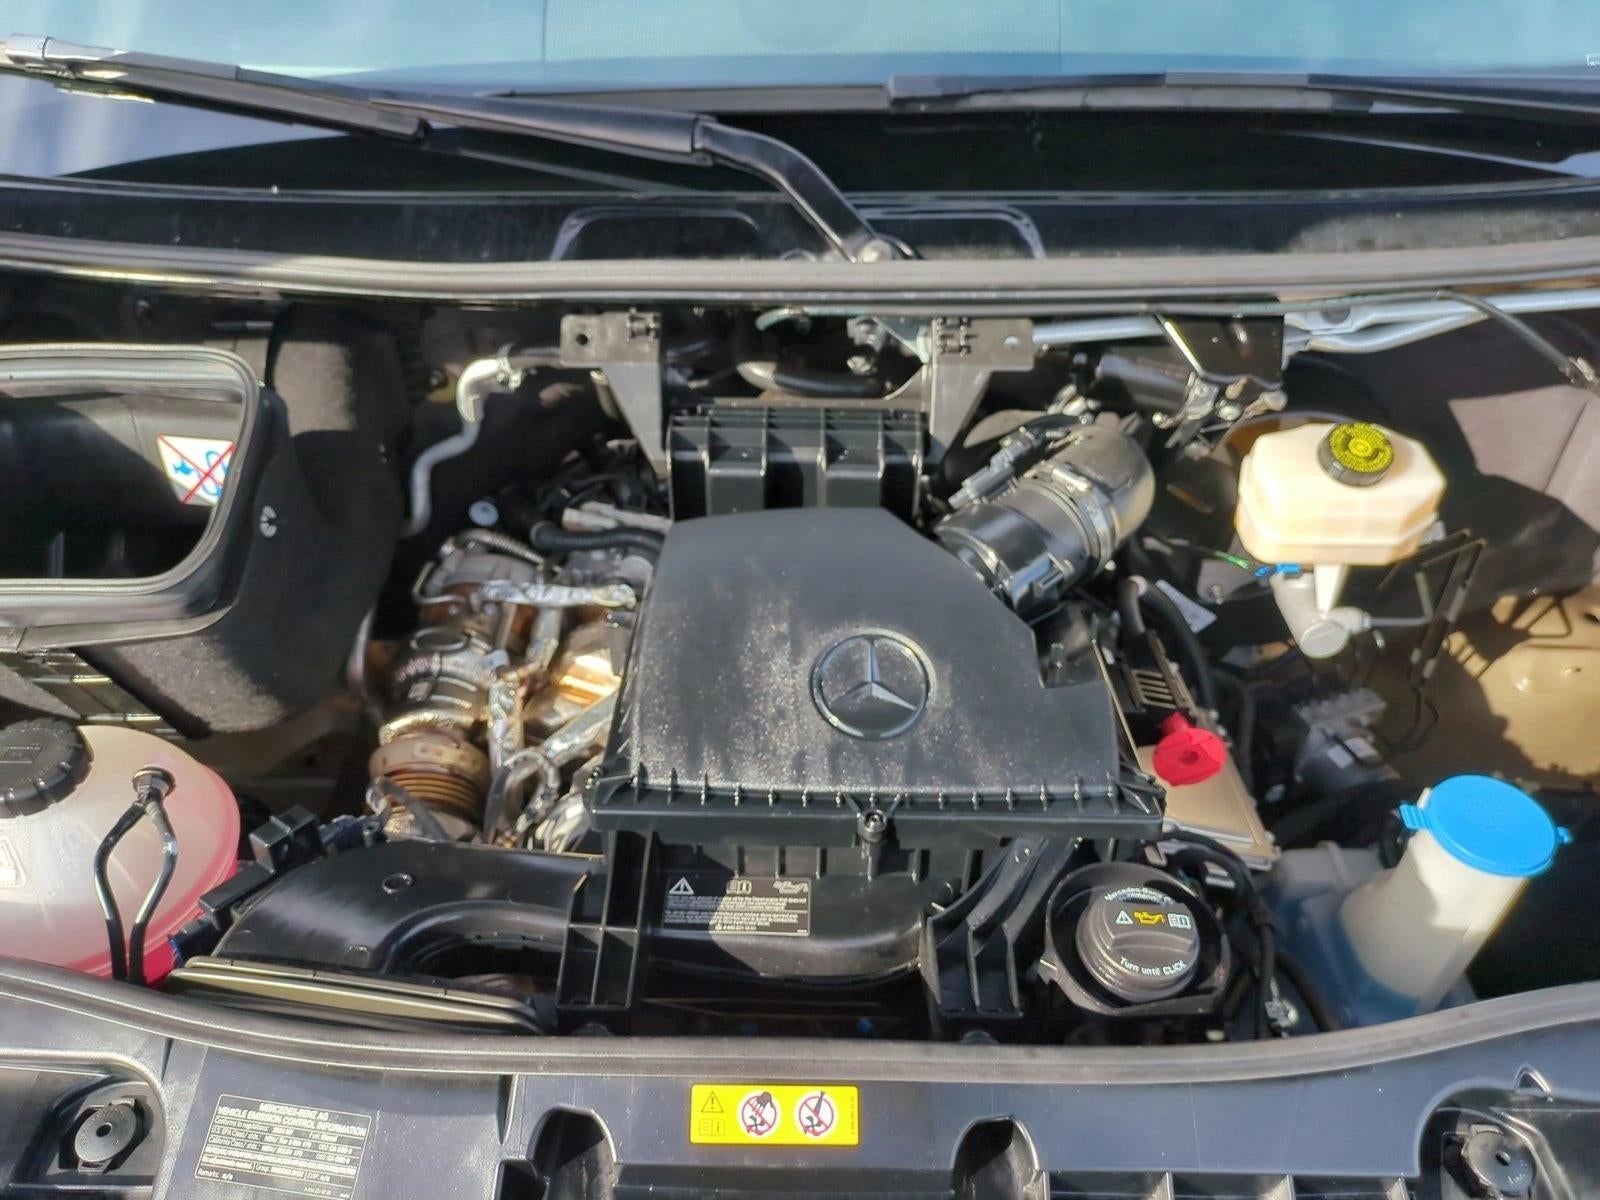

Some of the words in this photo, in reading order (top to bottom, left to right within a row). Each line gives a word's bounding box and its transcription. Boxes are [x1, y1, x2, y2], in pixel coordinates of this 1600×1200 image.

[1120, 956, 1140, 973] Turn
[1141, 967, 1160, 976] until
[1162, 960, 1187, 976] CLICK
[258, 1102, 317, 1119] MERCEDES-BENZ
[317, 1111, 329, 1120] AG
[216, 1105, 248, 1118] VEHICLE
[246, 1110, 282, 1123] EMISSION
[281, 1115, 316, 1129] CONTROL
[316, 1121, 366, 1137] INFORMATION
[208, 1135, 231, 1145] California
[197, 1167, 220, 1177] Remarks:
